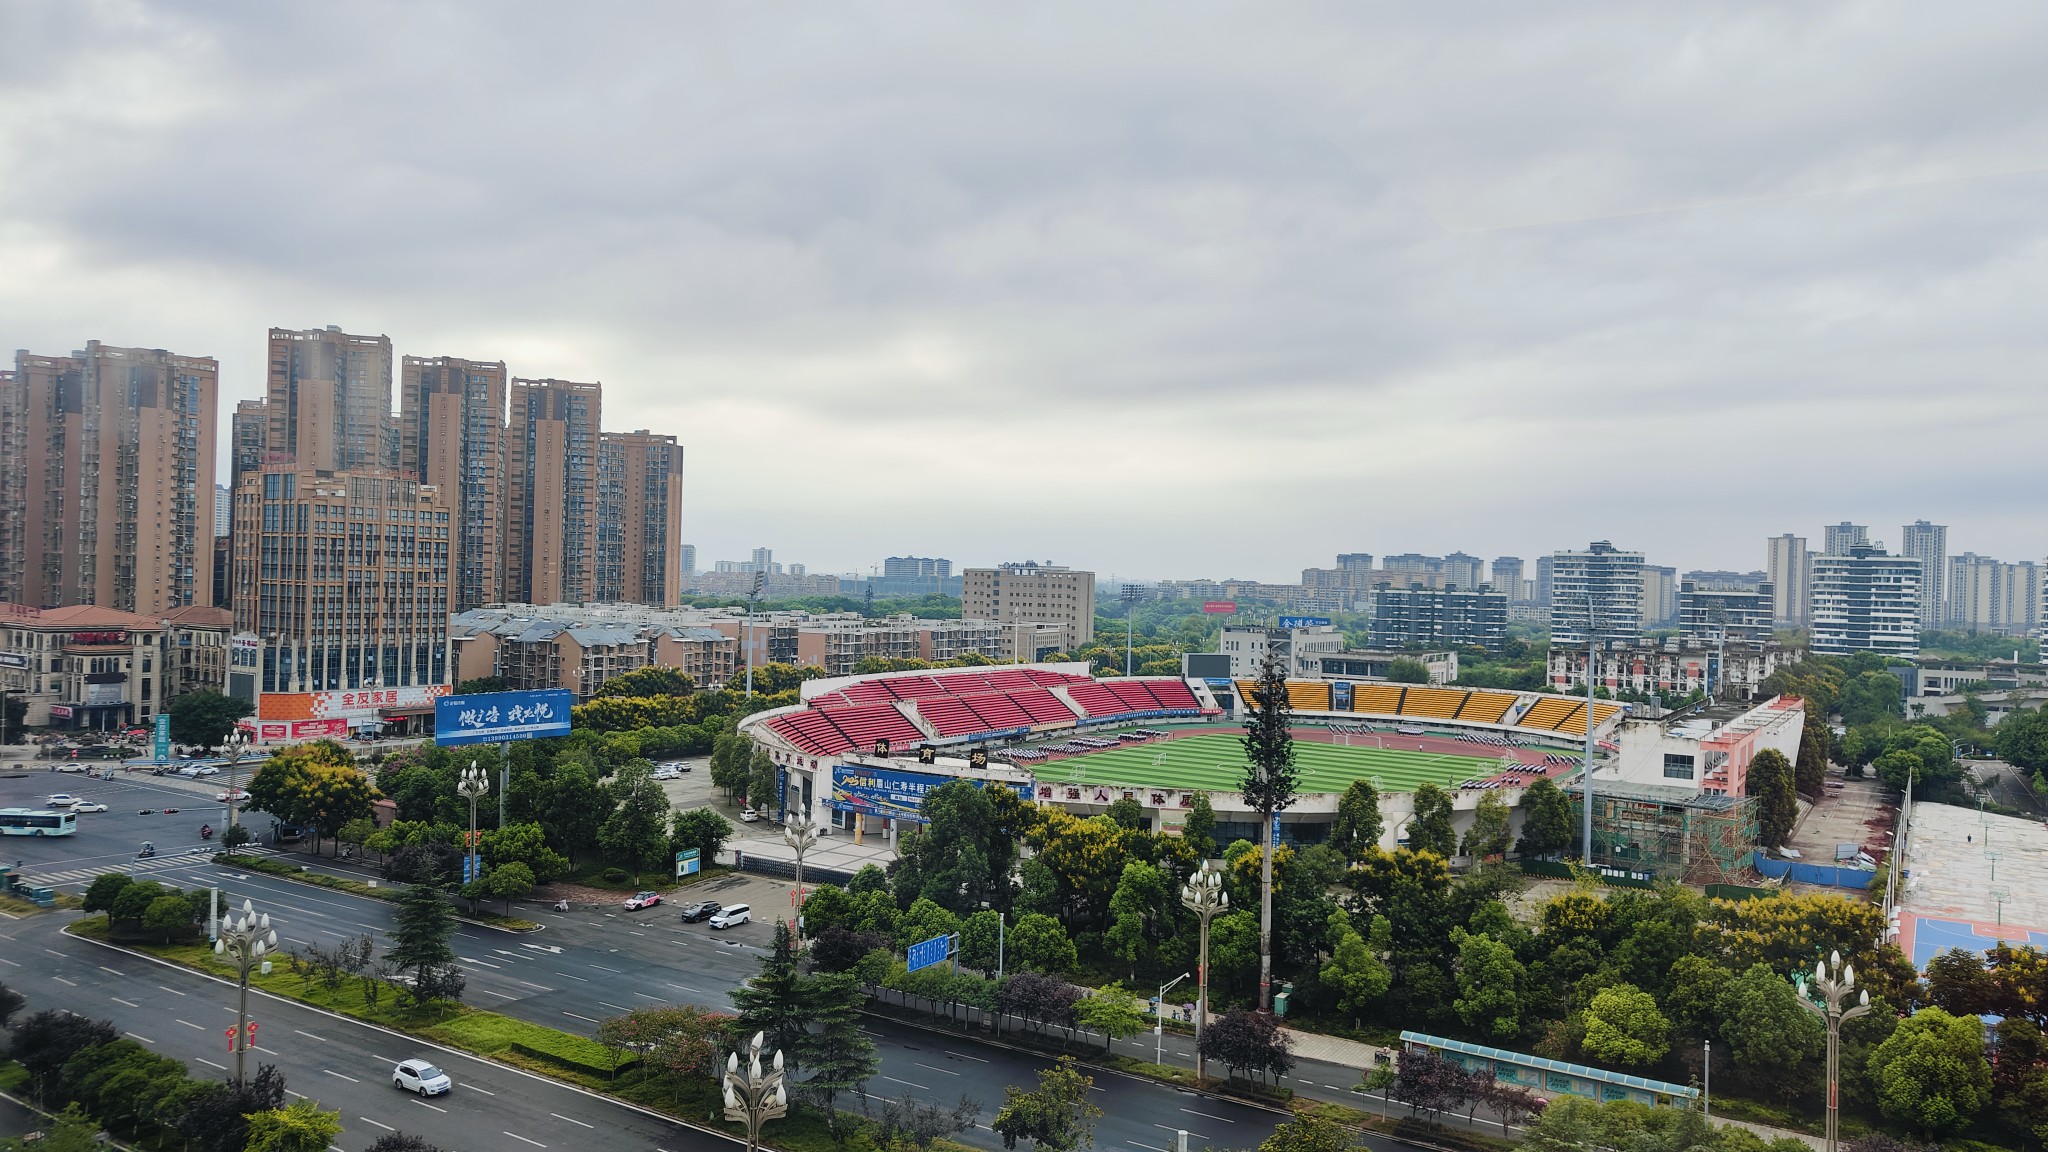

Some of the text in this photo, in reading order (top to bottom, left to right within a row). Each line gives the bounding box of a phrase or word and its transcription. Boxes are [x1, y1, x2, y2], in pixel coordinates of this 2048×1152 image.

[342, 690, 398, 706] 全友家居
[459, 706, 500, 728] 做广告
[876, 742, 986, 765] 体育场
